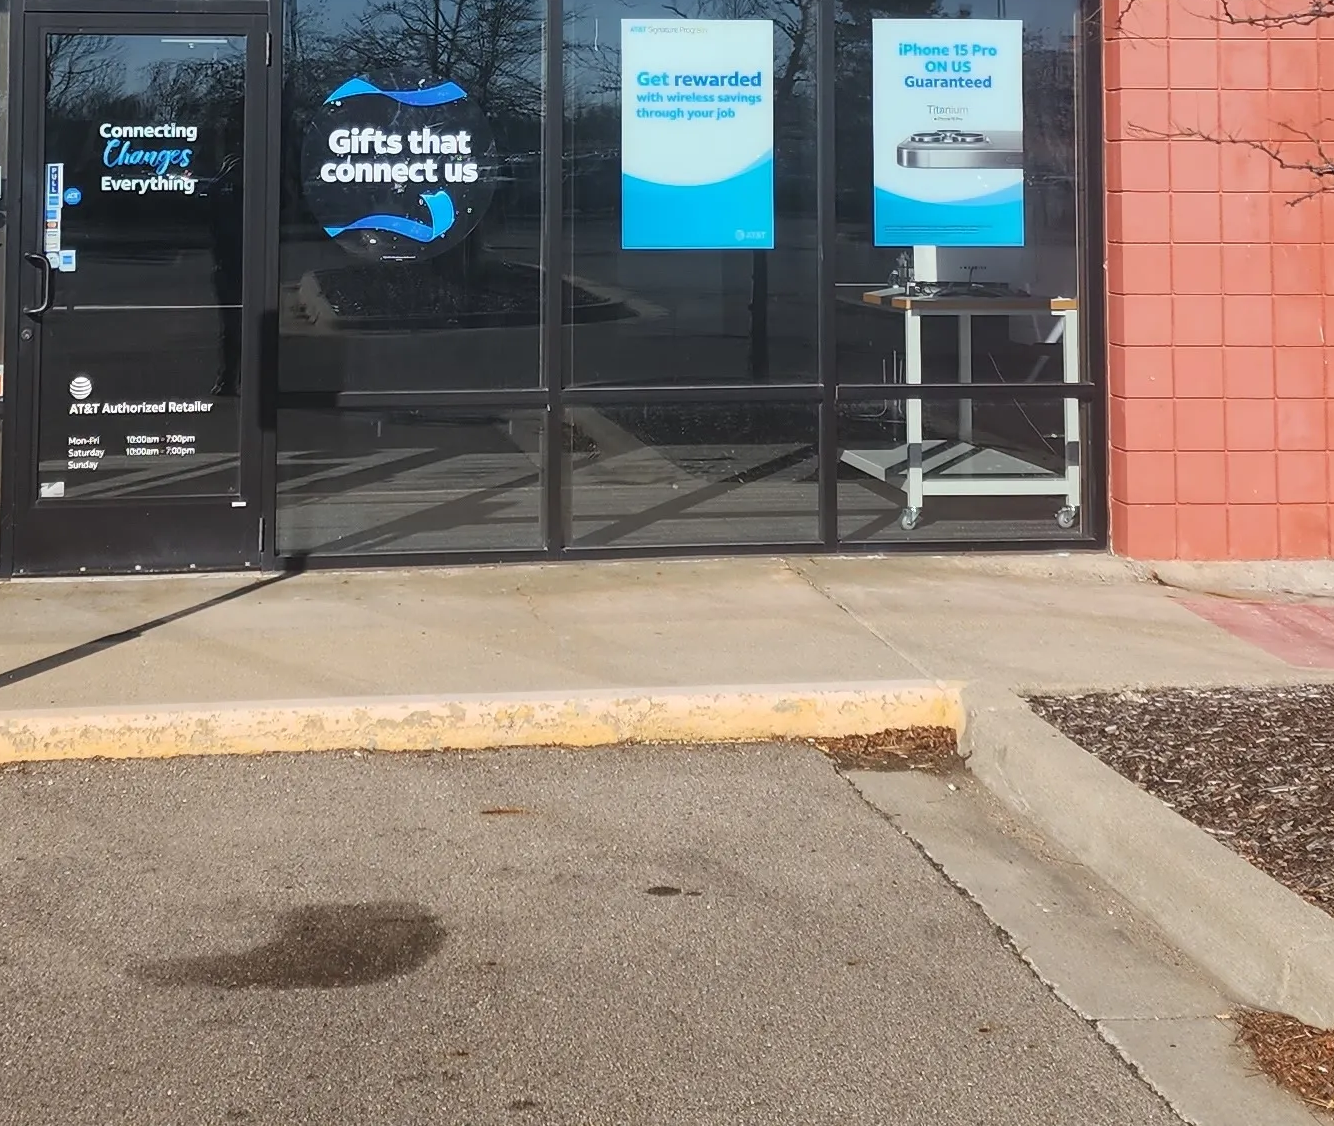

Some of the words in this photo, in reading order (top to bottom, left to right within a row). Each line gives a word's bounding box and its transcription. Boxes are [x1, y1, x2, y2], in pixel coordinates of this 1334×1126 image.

[898, 43, 949, 56] iPhone
[953, 44, 968, 56] 15
[972, 44, 997, 56] Pro
[925, 61, 947, 72] ON
[952, 61, 971, 72] US
[637, 72, 669, 86] Get
[674, 71, 762, 87] rewarded
[904, 75, 992, 88] Guaranteed
[636, 92, 663, 103] with
[667, 92, 714, 103] wireless
[718, 93, 762, 105] savings
[636, 108, 684, 120] through
[687, 109, 714, 120] your
[717, 108, 736, 120] job
[926, 104, 968, 115] Titanium
[99, 123, 198, 142] Connecting
[328, 128, 403, 155] Gifts
[408, 128, 472, 155] that
[103, 138, 193, 175] Changes
[320, 159, 439, 183] connect
[444, 162, 479, 183] us
[101, 175, 196, 195] Everything
[69, 403, 100, 415] AT&T
[101, 401, 167, 414] Authorized
[168, 401, 213, 413] Retailer
[68, 436, 100, 445] Mon-Fri
[126, 435, 160, 444] 10:00am
[165, 434, 196, 445] 7:00pm
[67, 448, 105, 459] Saturday
[125, 447, 160, 456] 10:00am
[165, 446, 196, 457] 7:00pm
[67, 460, 99, 471] Sunday
